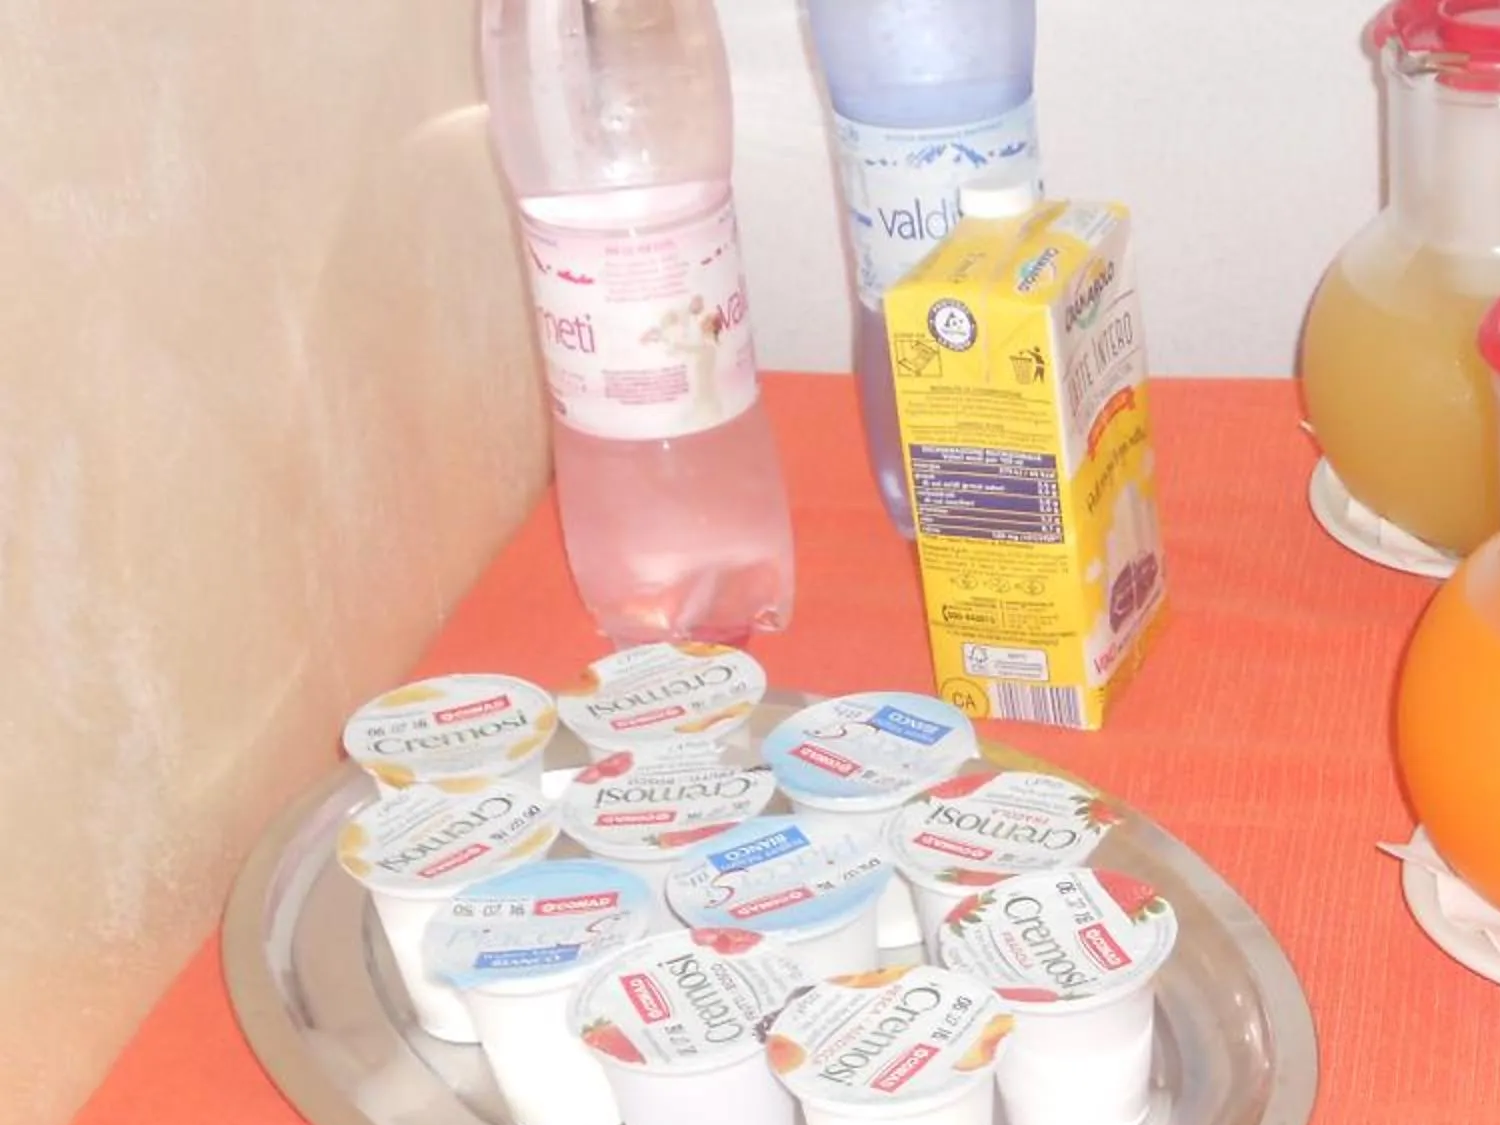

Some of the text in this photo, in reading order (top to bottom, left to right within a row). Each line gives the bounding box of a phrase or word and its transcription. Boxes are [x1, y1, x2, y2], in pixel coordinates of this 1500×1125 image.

[951, 691, 977, 711] CA
[372, 709, 528, 757] Cremosi
[599, 777, 753, 808] Cremosi
[378, 796, 513, 873] Cremosi
[931, 805, 1077, 849] Cremosi
[1004, 896, 1088, 988] Cremosi
[669, 954, 743, 1044] Cremosi
[822, 987, 942, 1086] Cremosi
